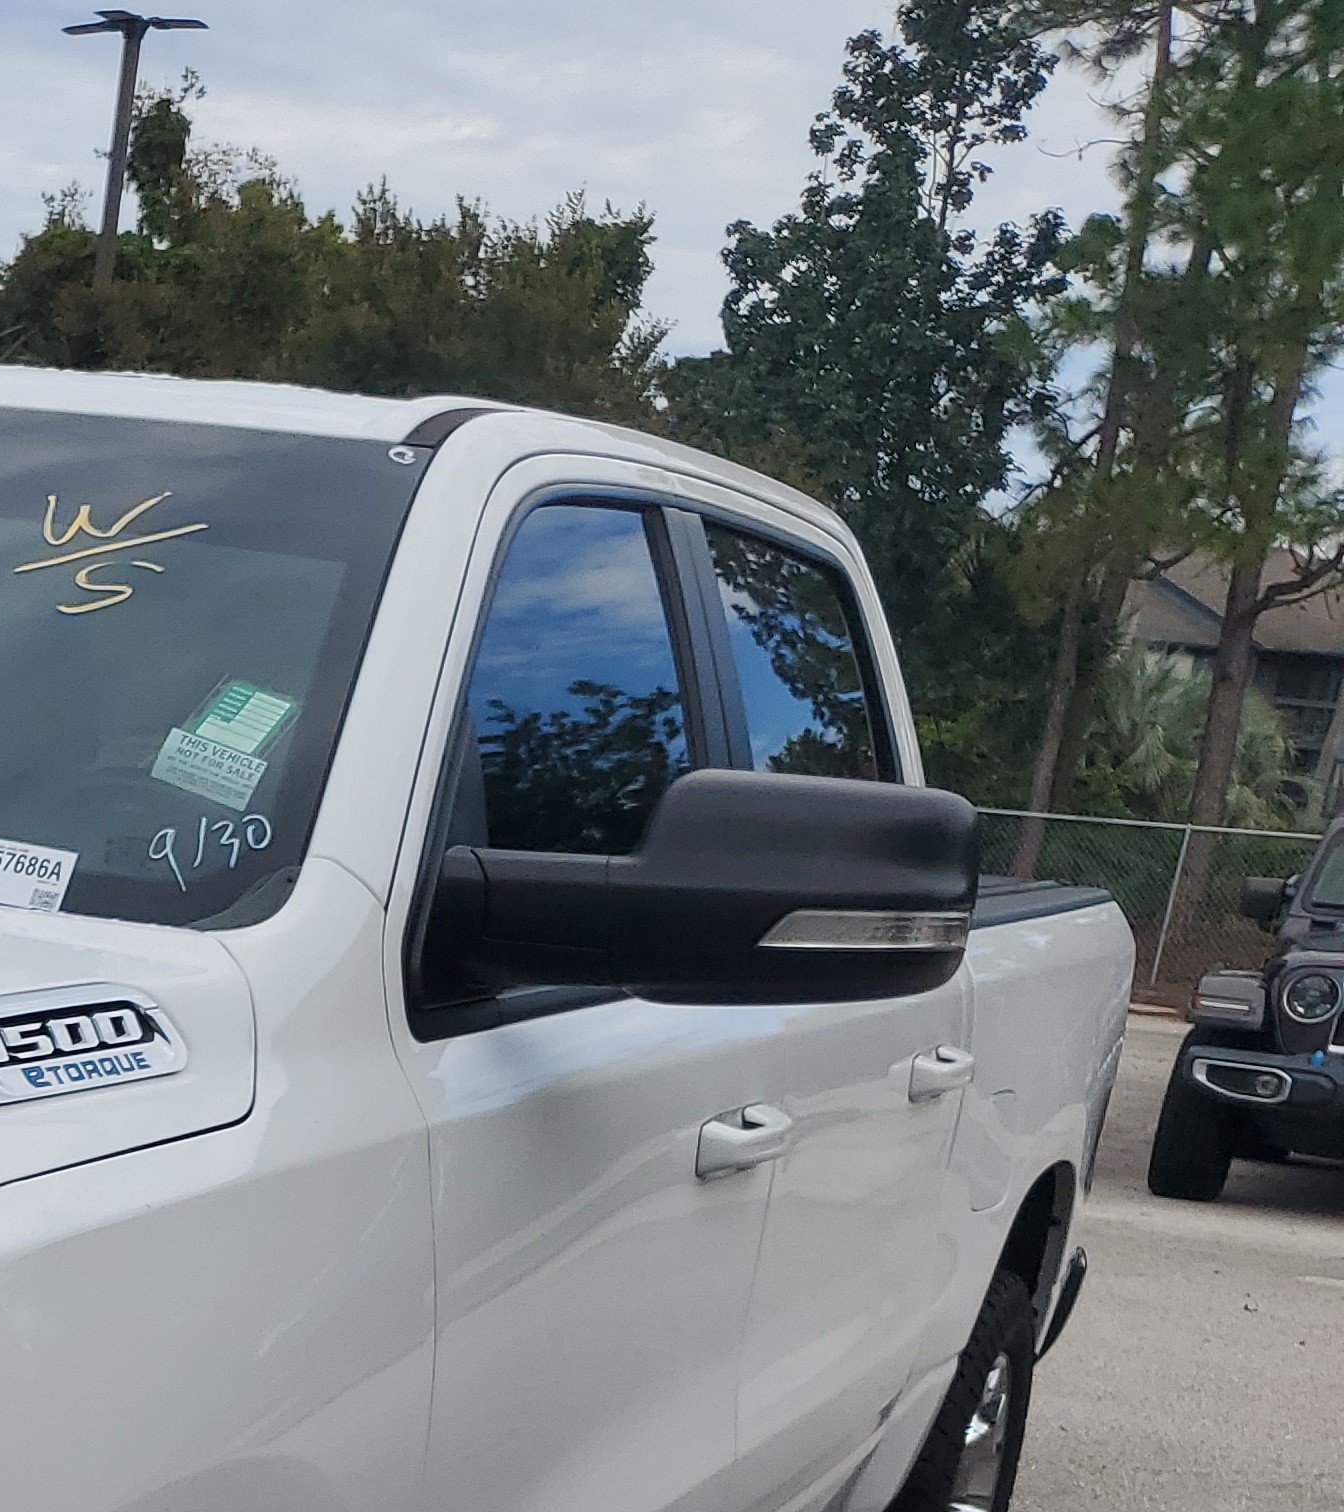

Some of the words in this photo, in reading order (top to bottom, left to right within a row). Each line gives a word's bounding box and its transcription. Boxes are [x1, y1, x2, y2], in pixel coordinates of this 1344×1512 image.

[180, 734, 208, 753] THIS
[212, 745, 264, 773] VEHICLE
[148, 813, 272, 891] 9/30
